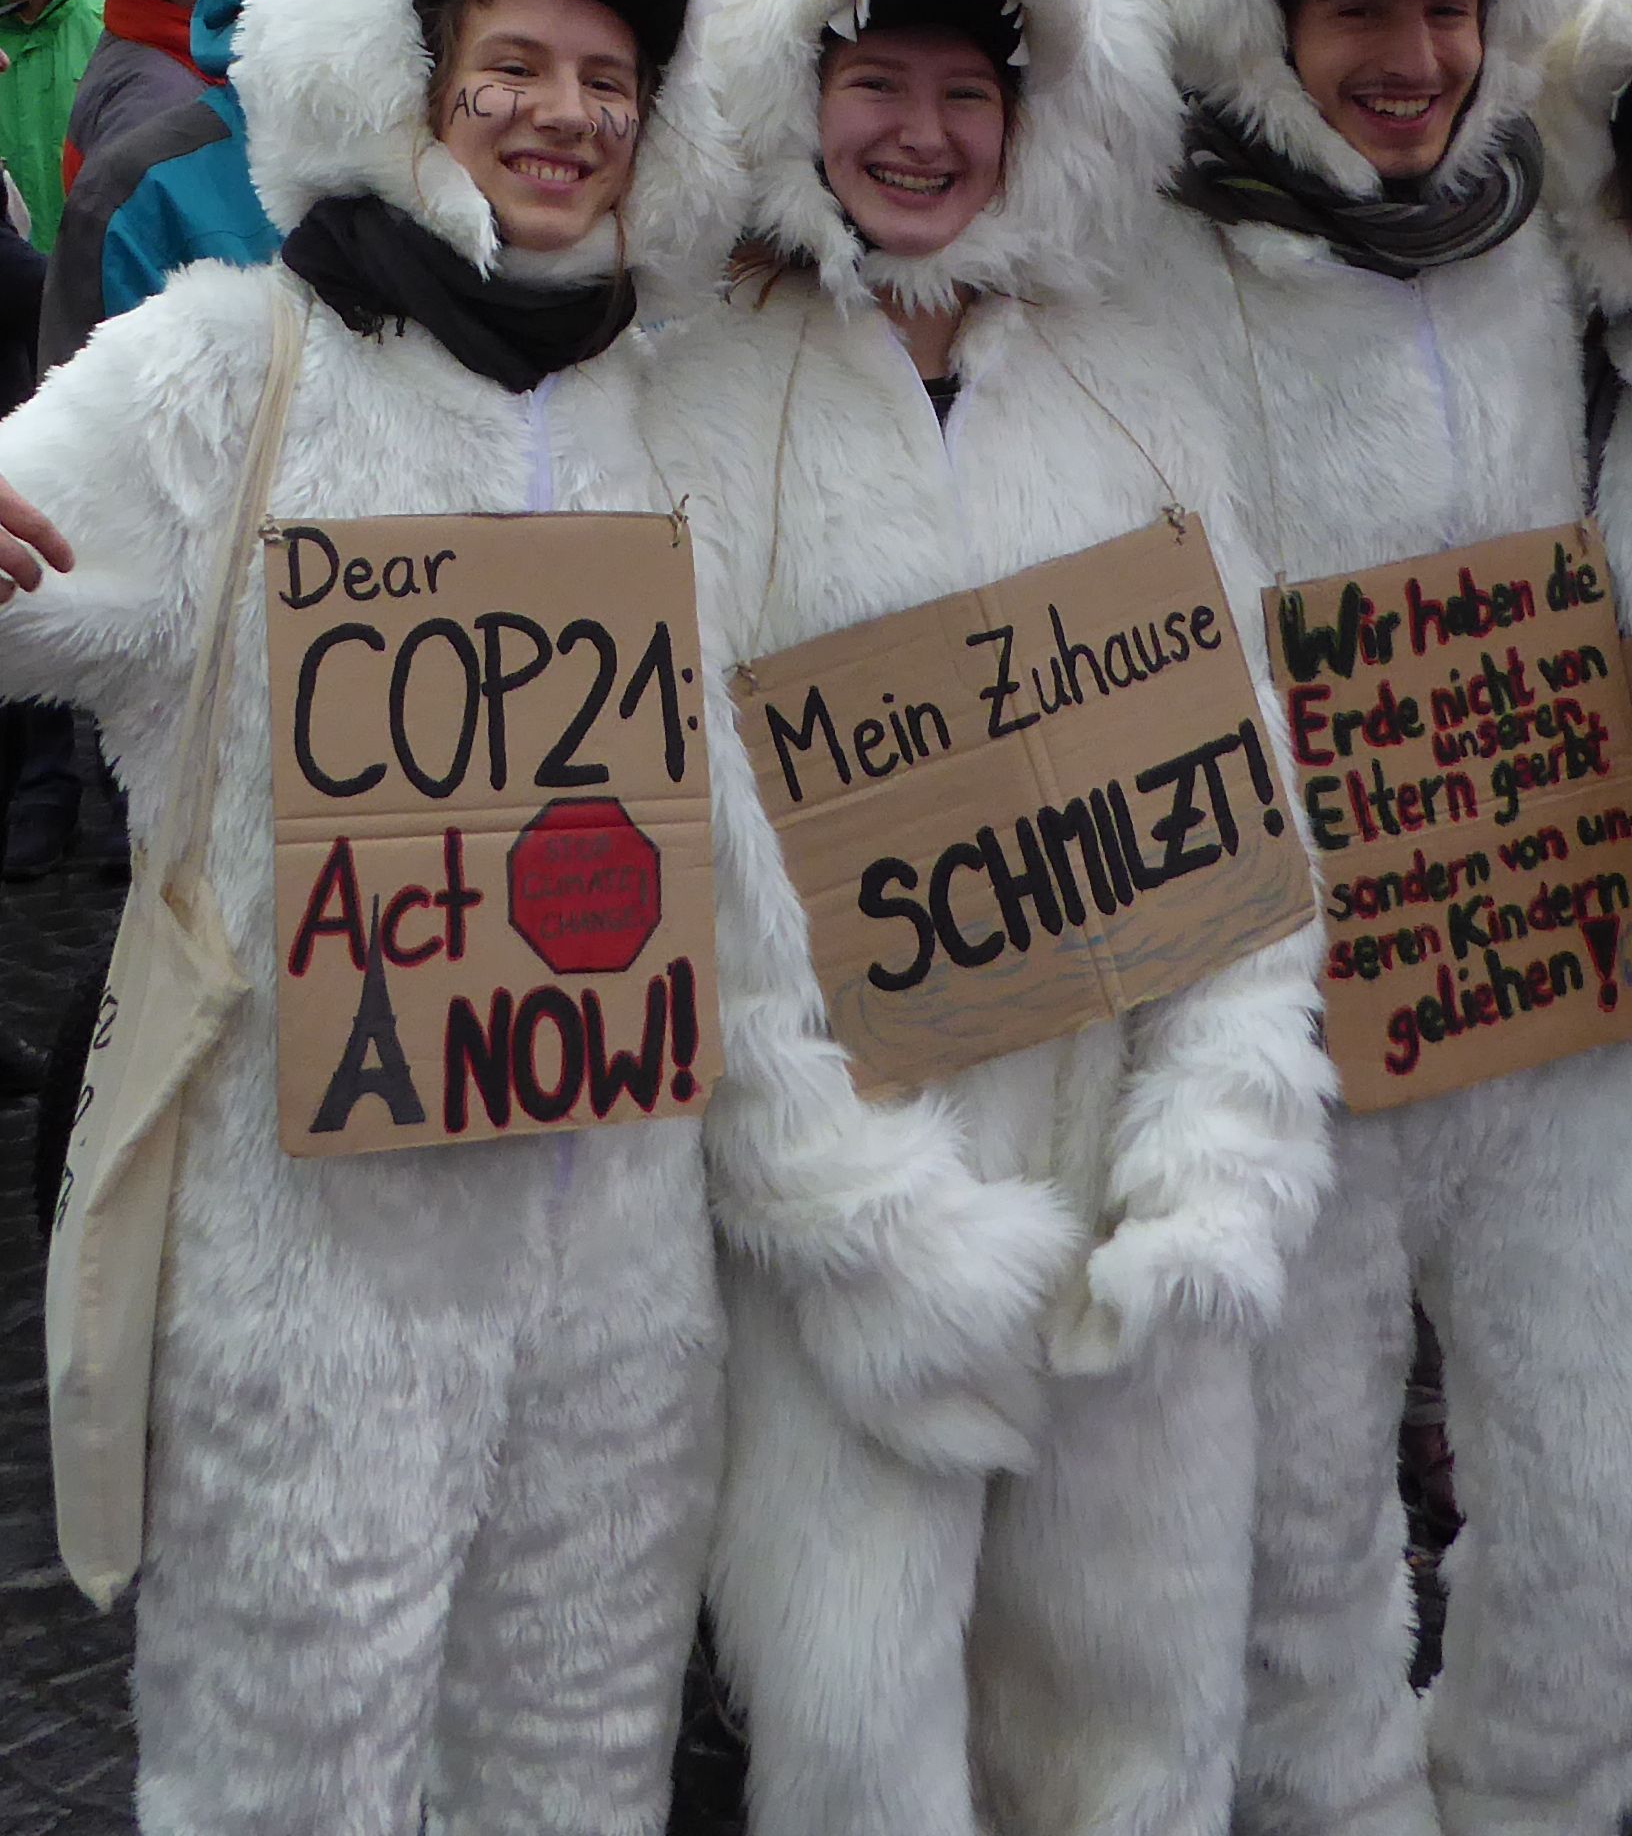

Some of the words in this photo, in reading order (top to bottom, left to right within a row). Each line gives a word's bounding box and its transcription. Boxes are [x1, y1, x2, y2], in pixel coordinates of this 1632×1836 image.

[279, 526, 456, 609] Dear
[1278, 581, 1400, 682] Wir
[1405, 567, 1535, 655] haben
[1546, 542, 1604, 611] die
[294, 610, 699, 798] COP21:
[765, 684, 952, 802] Mein
[966, 602, 1222, 738] Zuhause
[1288, 679, 1425, 766] Erde
[1430, 646, 1535, 731] nicht
[1537, 644, 1608, 692] von
[1432, 696, 1584, 767] unseren
[1306, 759, 1478, 851] Eltern
[1490, 712, 1609, 826] geerbt
[287, 826, 485, 977] Act
[858, 717, 1285, 992] SCHMILZT!
[1327, 849, 1490, 922] sondern
[1498, 825, 1568, 871] von
[1328, 920, 1441, 981] seren
[1448, 871, 1630, 961] Kindern
[443, 956, 701, 1134] NOW!
